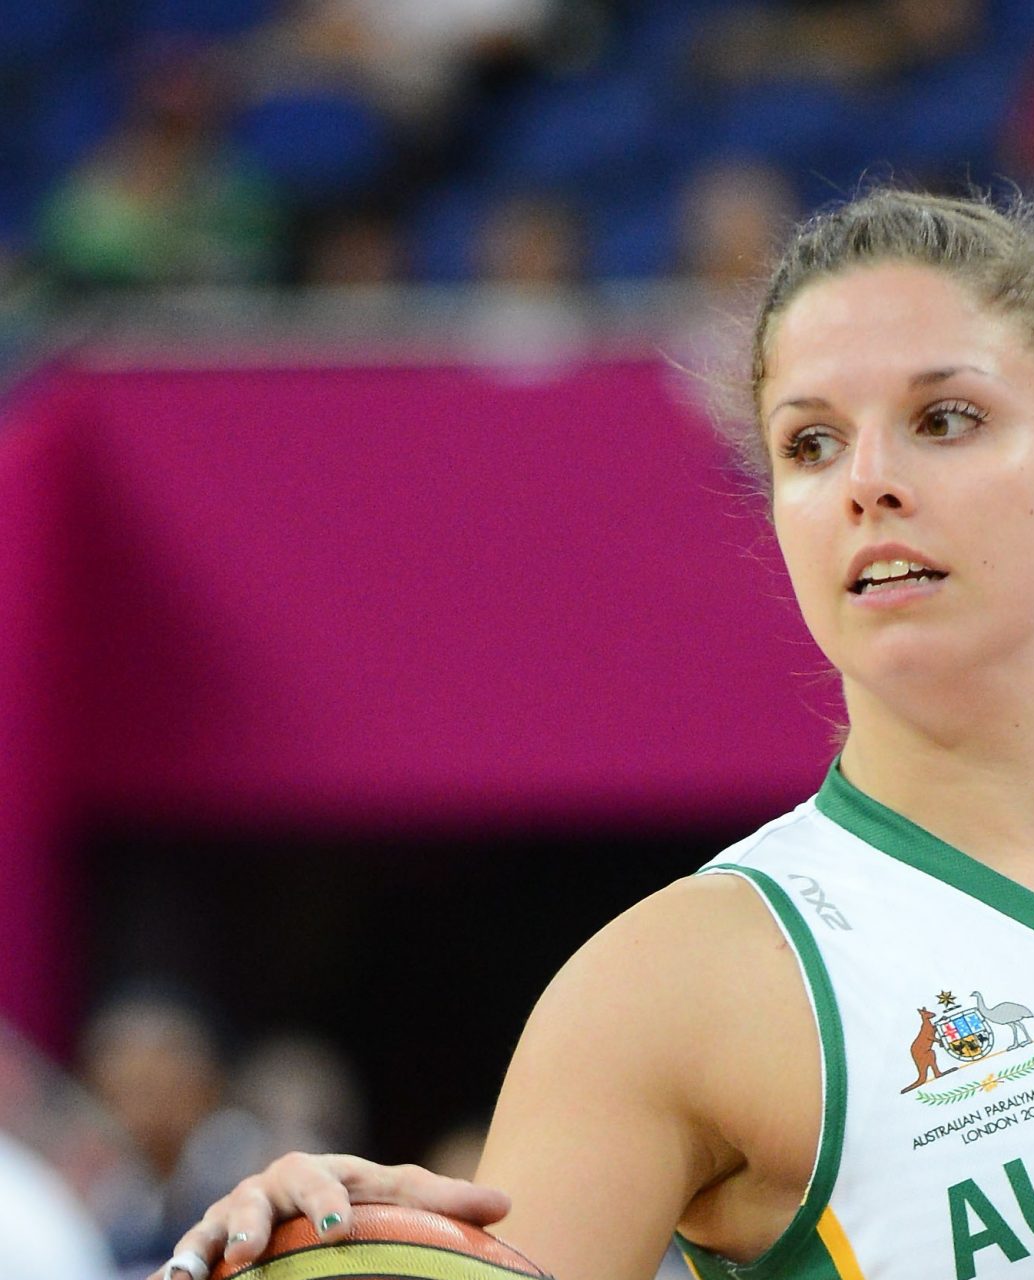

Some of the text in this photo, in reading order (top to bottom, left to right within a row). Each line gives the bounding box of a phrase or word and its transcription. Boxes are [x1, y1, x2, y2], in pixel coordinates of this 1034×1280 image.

[787, 873, 853, 931] 2XU
[912, 1110, 983, 1150] AUSTRALIAN
[961, 1113, 1018, 1144] LONDON
